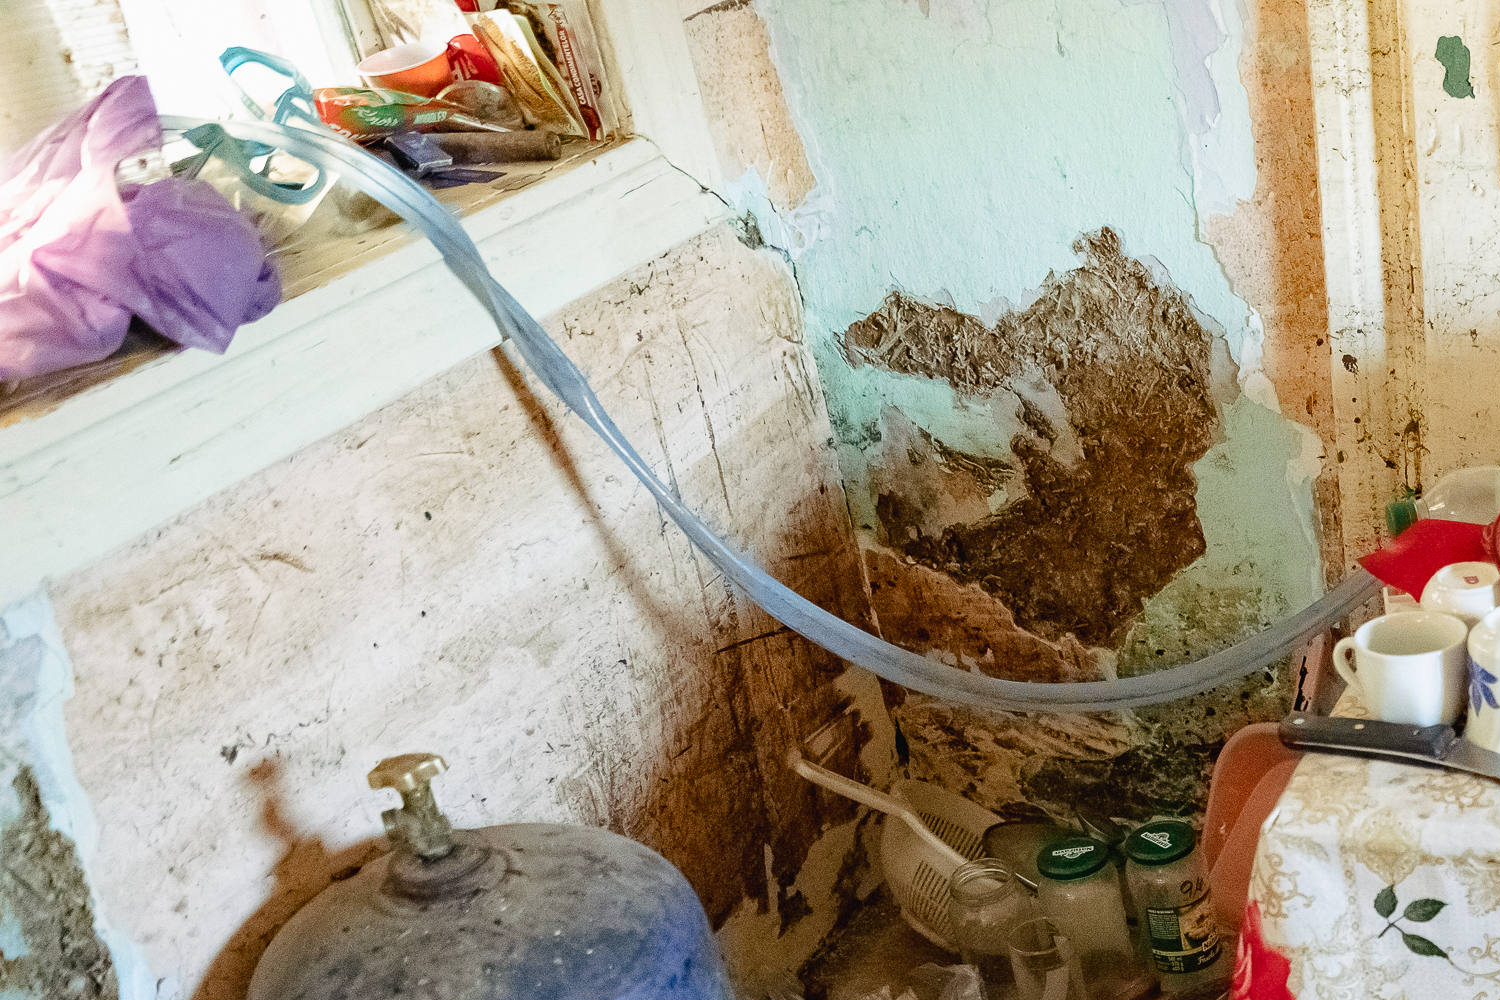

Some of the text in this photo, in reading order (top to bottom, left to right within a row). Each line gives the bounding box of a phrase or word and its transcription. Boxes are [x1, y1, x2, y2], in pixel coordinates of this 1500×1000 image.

[559, 30, 587, 105] CASA CONDIMENTELOR
[413, 111, 448, 124] NOODLES
